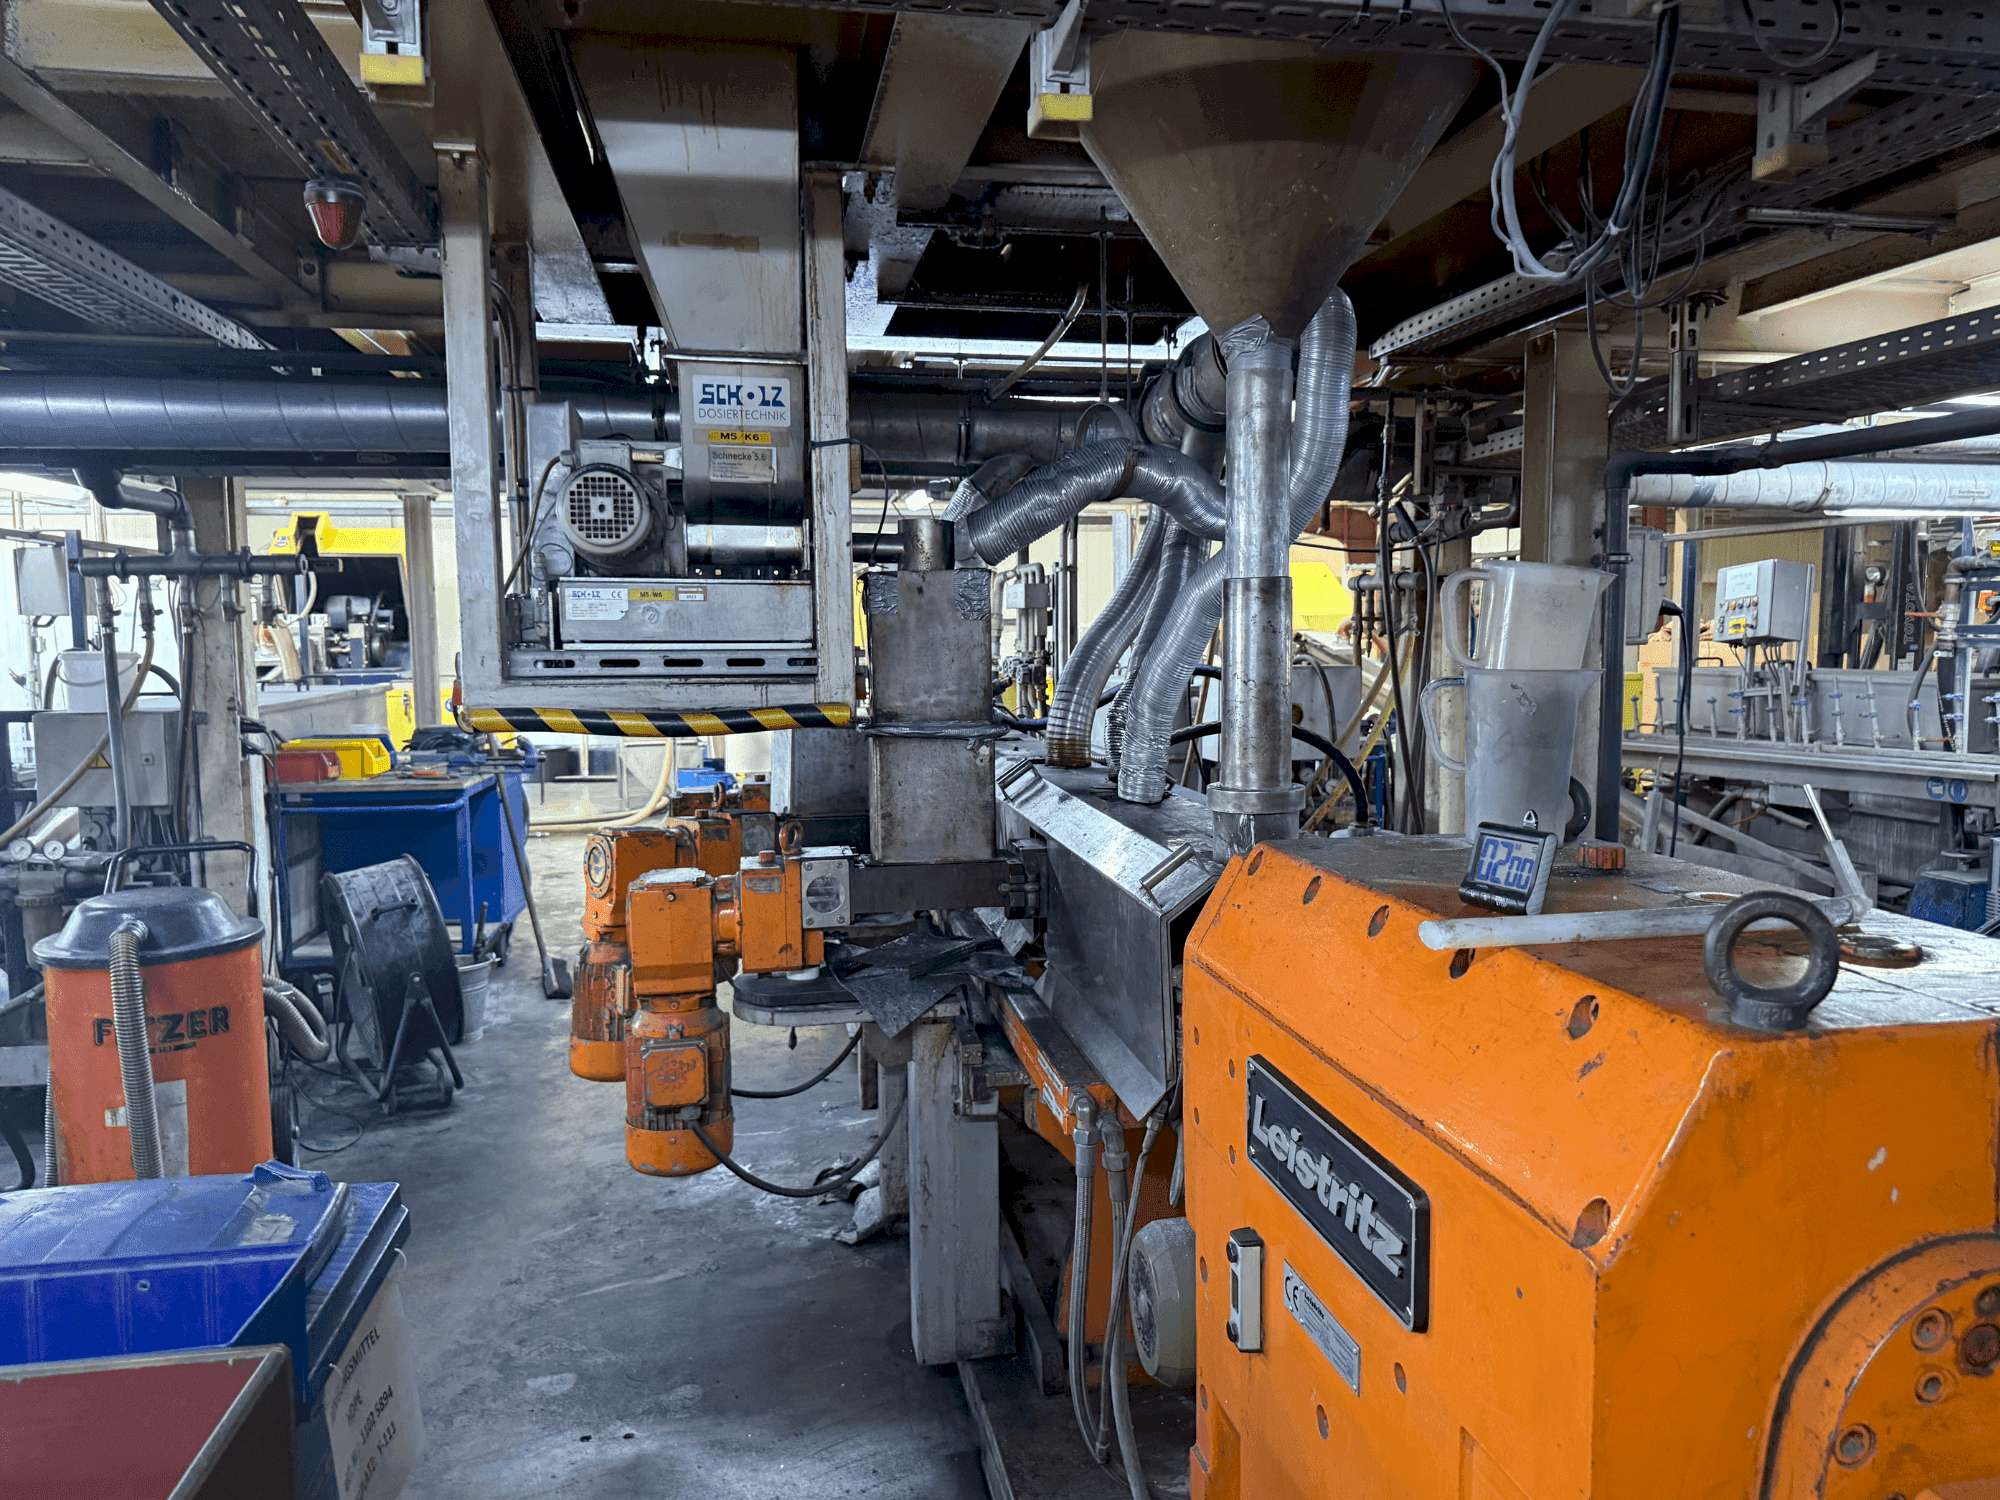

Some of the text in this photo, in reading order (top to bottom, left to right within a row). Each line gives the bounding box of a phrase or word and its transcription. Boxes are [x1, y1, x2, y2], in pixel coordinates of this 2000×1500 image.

[698, 383, 786, 407] SCHOLZ
[698, 408, 786, 421] DOSIERTECHNIK
[712, 451, 766, 461] Schnecke 5.6
[1903, 582, 1916, 645] TOYOTA
[1252, 1094, 1407, 1279] Leistritz
[1303, 1290, 1326, 1320] Leistritz
